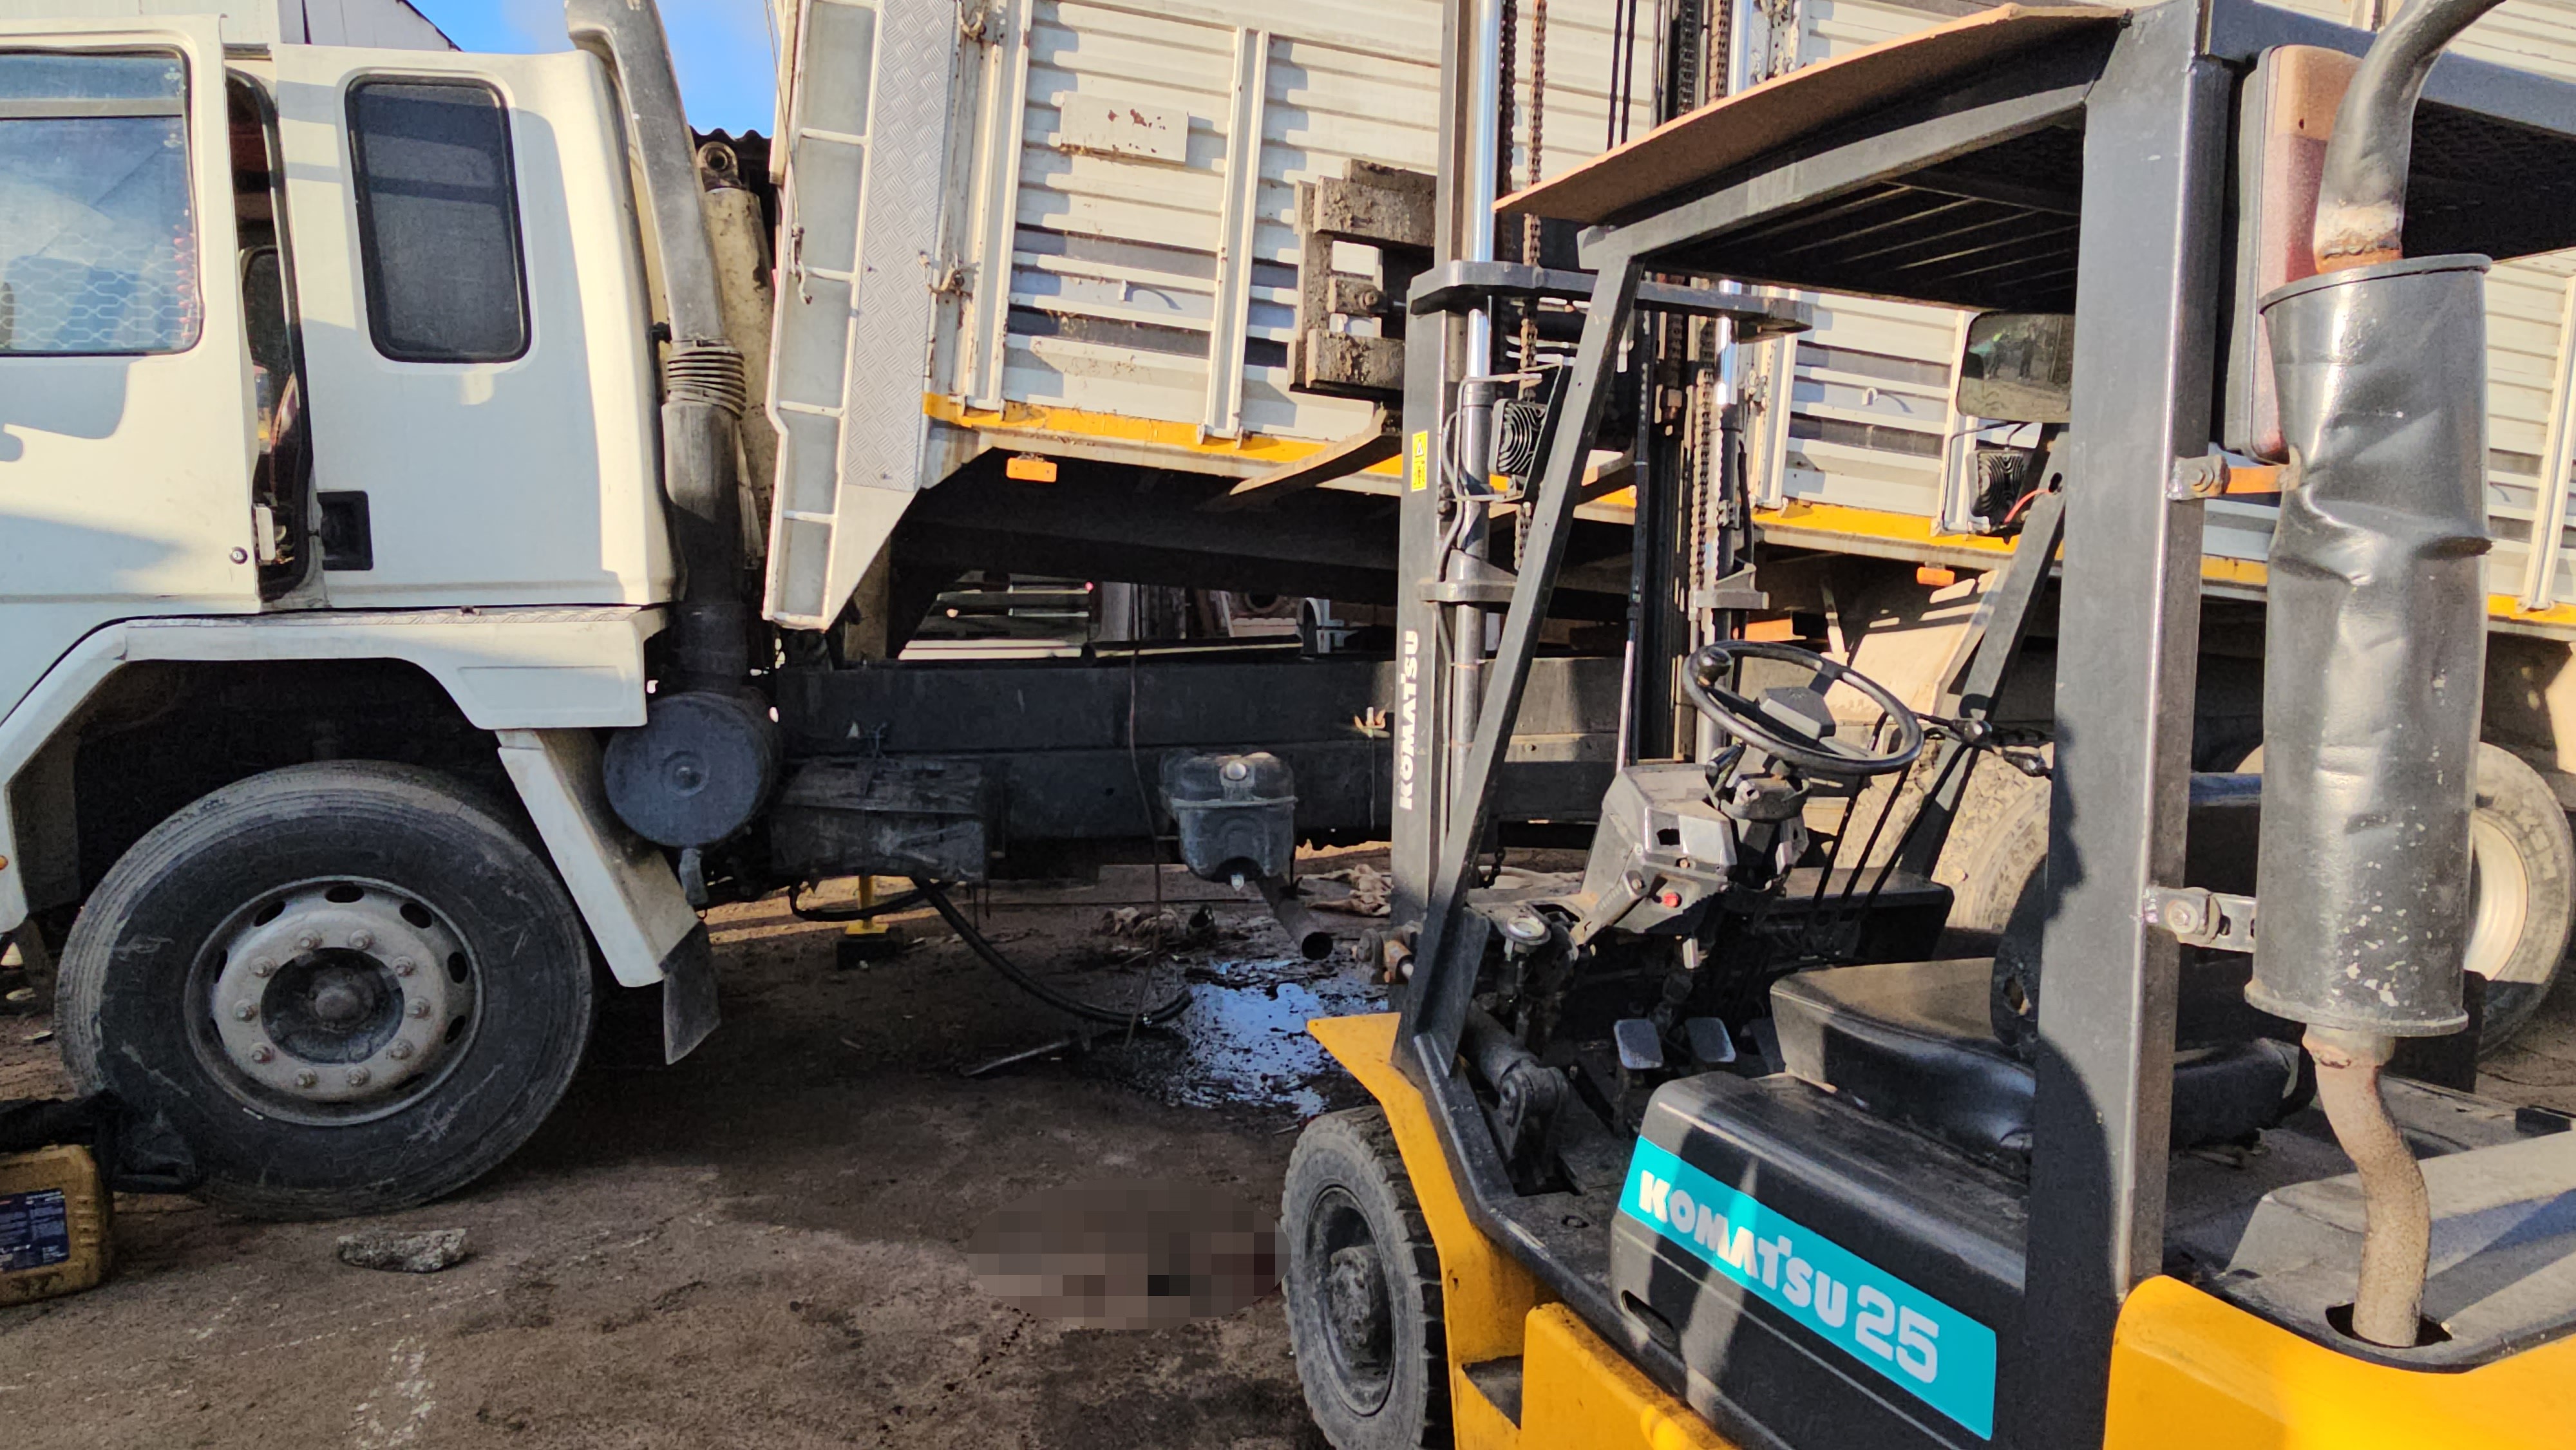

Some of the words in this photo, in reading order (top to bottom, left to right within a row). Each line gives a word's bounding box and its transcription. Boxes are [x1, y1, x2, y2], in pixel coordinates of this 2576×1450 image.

[1399, 630, 1418, 810] KOMATSU
[1638, 1169, 1848, 1328] KOMATSU
[1855, 1285, 1940, 1384] 25
